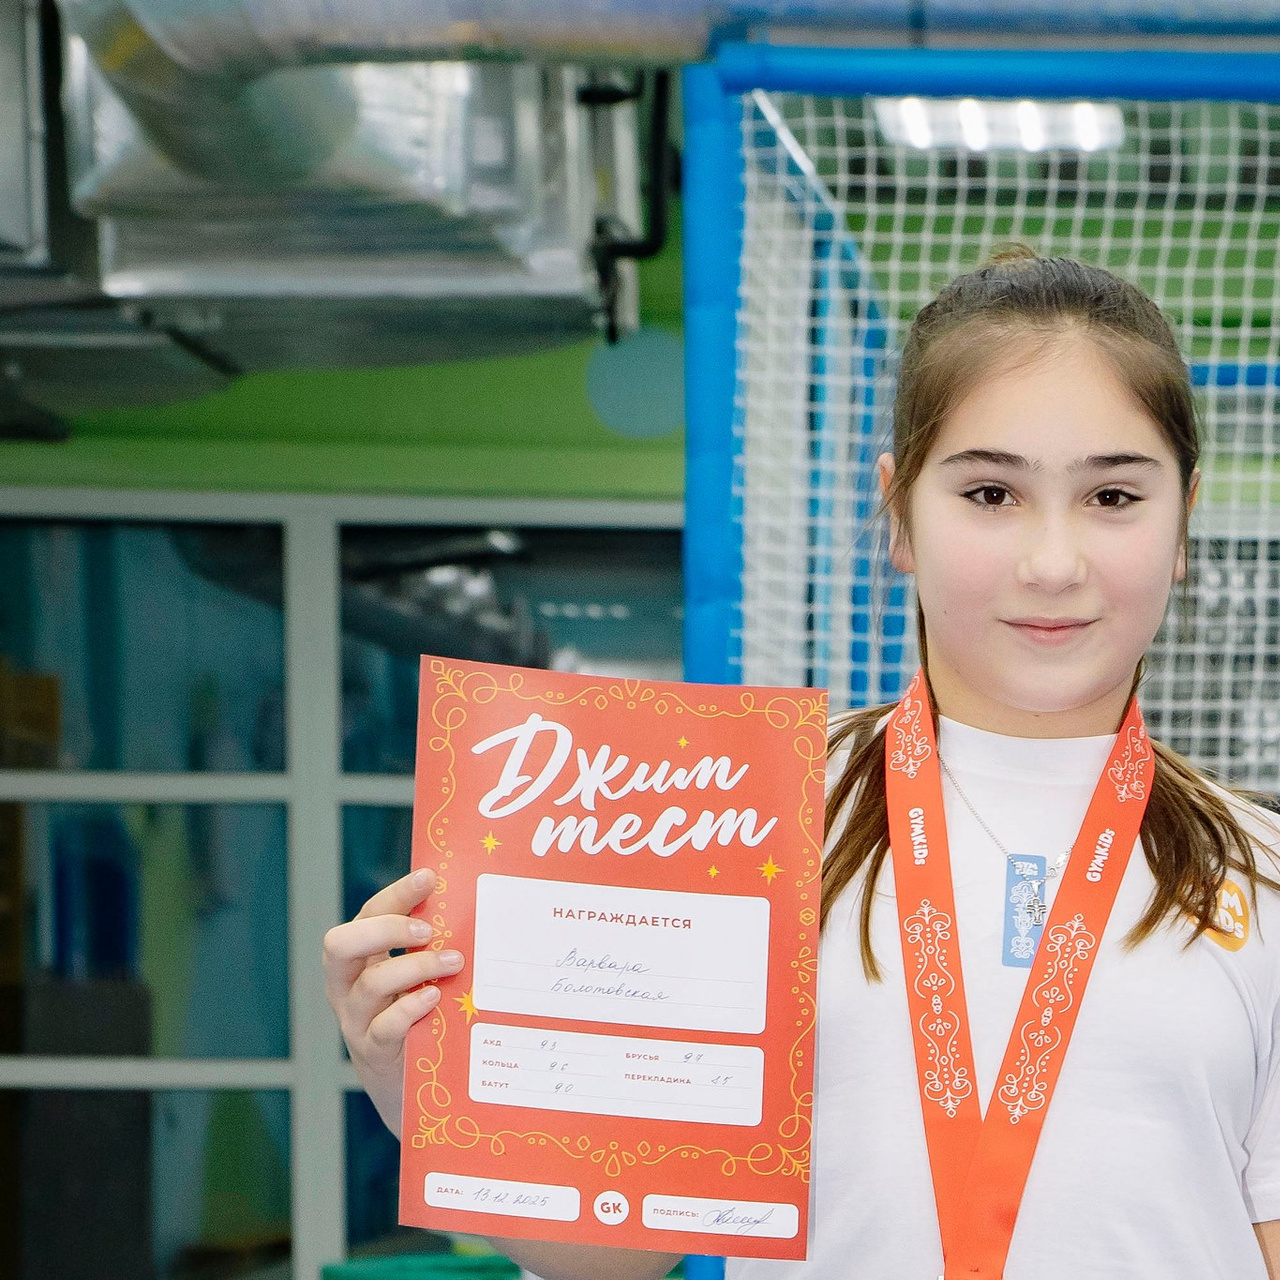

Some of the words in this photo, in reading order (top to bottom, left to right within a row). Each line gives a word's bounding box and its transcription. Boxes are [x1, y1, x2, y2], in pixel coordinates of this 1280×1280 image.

[531, 806, 778, 858] тест
[553, 907, 692, 929] НАГРАЖДАЕТСЯ
[625, 1052, 660, 1061] БРУСЬЯ
[481, 1059, 519, 1069] КОЛЬЦА
[481, 1080, 509, 1089] БАТУТ
[624, 1073, 692, 1085] ПЕРЕКЛАДИНА
[600, 1201, 622, 1214] GK
